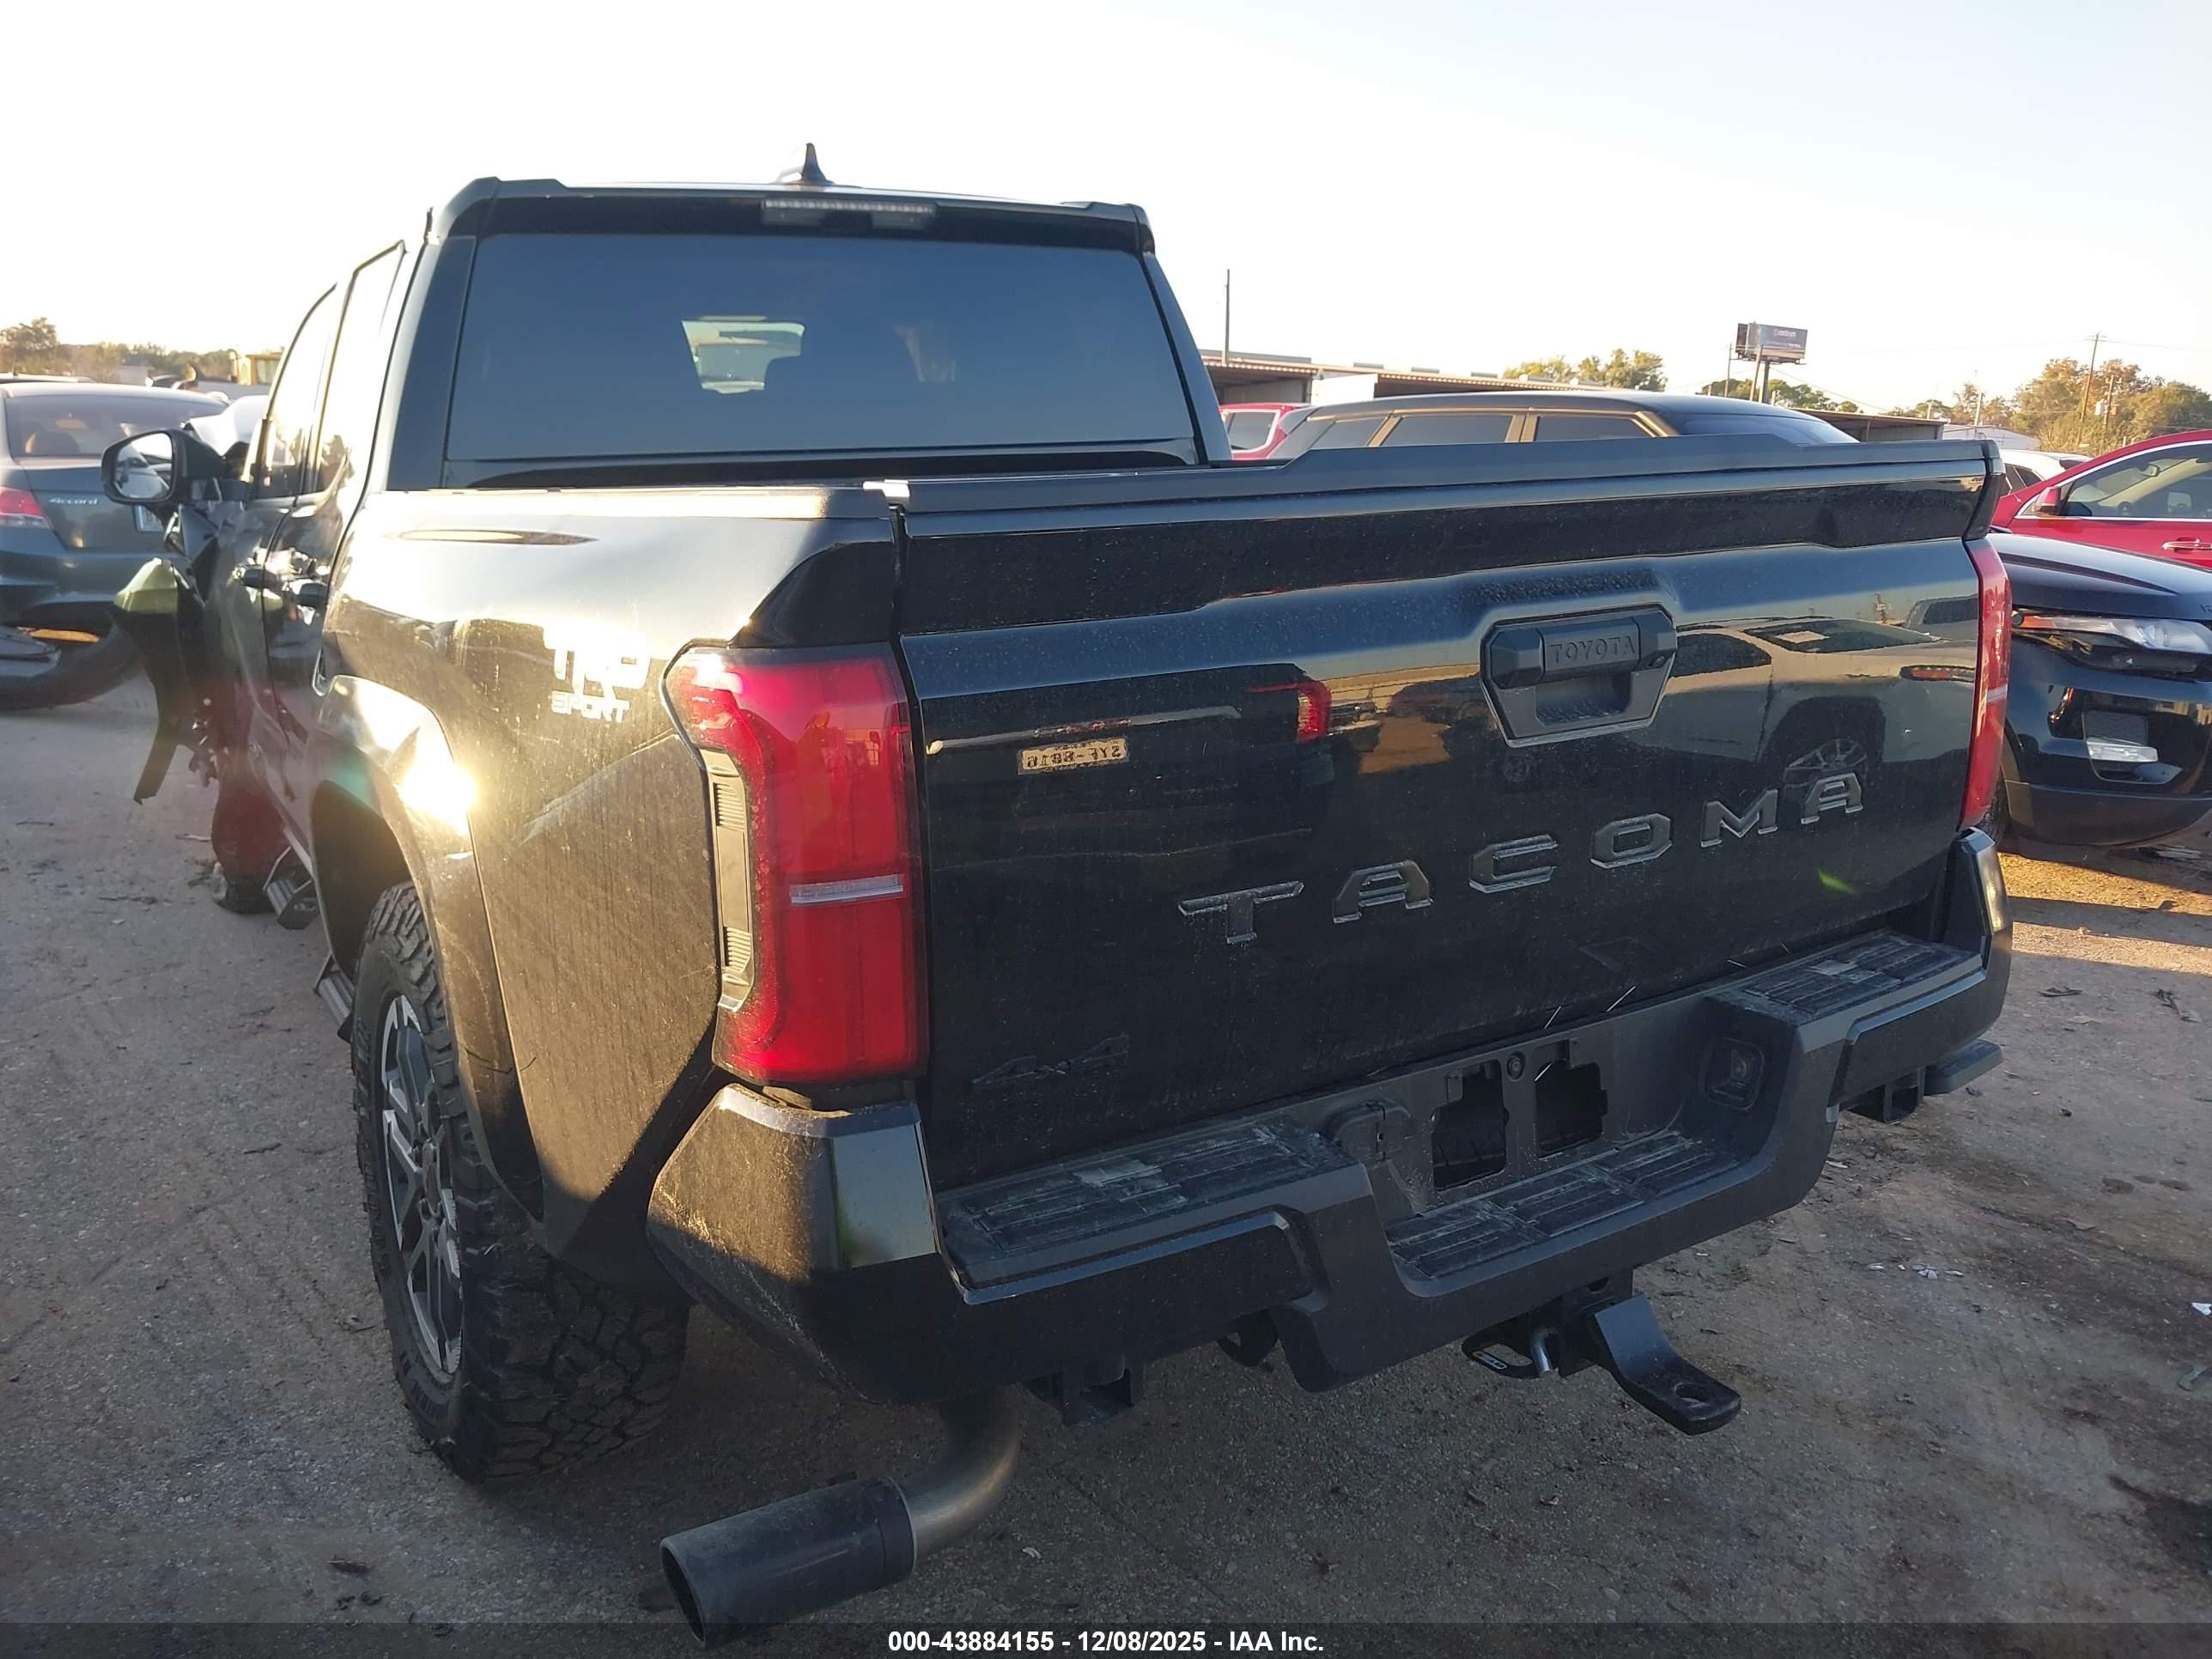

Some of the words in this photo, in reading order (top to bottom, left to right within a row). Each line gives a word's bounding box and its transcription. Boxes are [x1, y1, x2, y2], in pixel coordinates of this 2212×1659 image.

[543, 620, 651, 697] TRD
[1549, 635, 1635, 664] TOYOTA
[550, 690, 630, 723] SPORT
[1178, 772, 1864, 944] TACOMA
